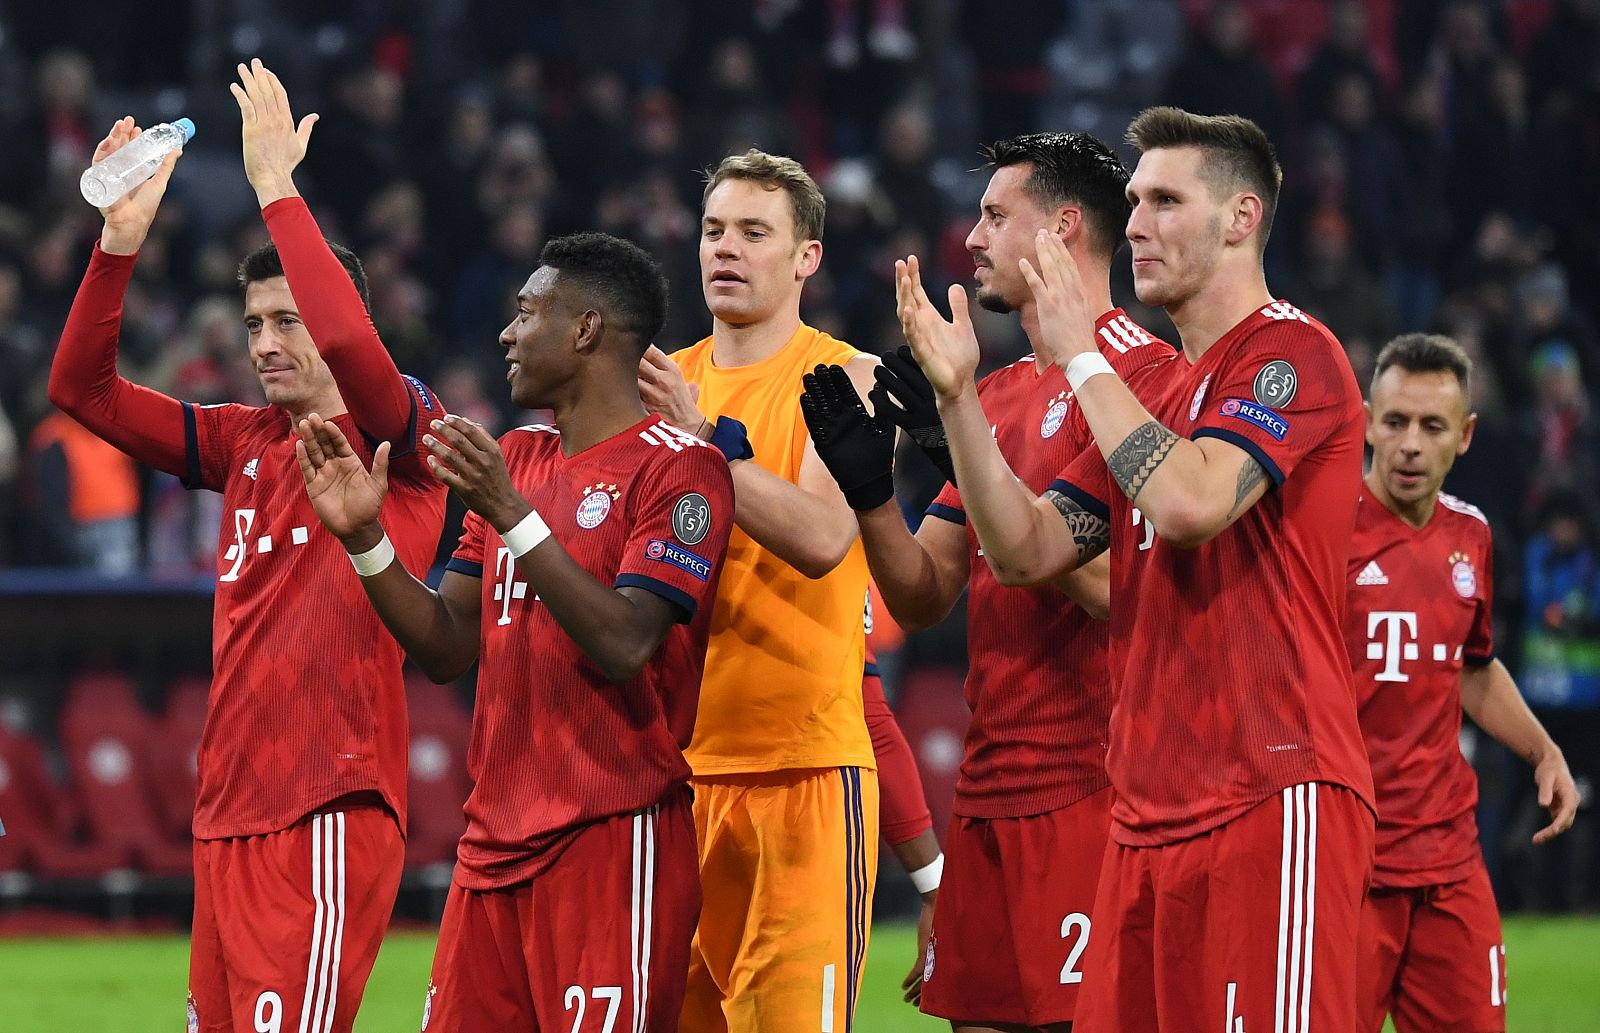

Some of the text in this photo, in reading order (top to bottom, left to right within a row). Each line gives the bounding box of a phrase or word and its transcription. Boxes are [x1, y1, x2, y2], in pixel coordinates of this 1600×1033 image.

[401, 374, 432, 410] SPECT
[1267, 383, 1280, 397] 5
[1240, 405, 1287, 435] RESPECT
[685, 517, 696, 531] 5
[665, 548, 710, 576] RESPECT
[1367, 611, 1418, 683] T
[1060, 912, 1092, 984] 2
[254, 991, 283, 1033] 9
[564, 985, 622, 1033] 27
